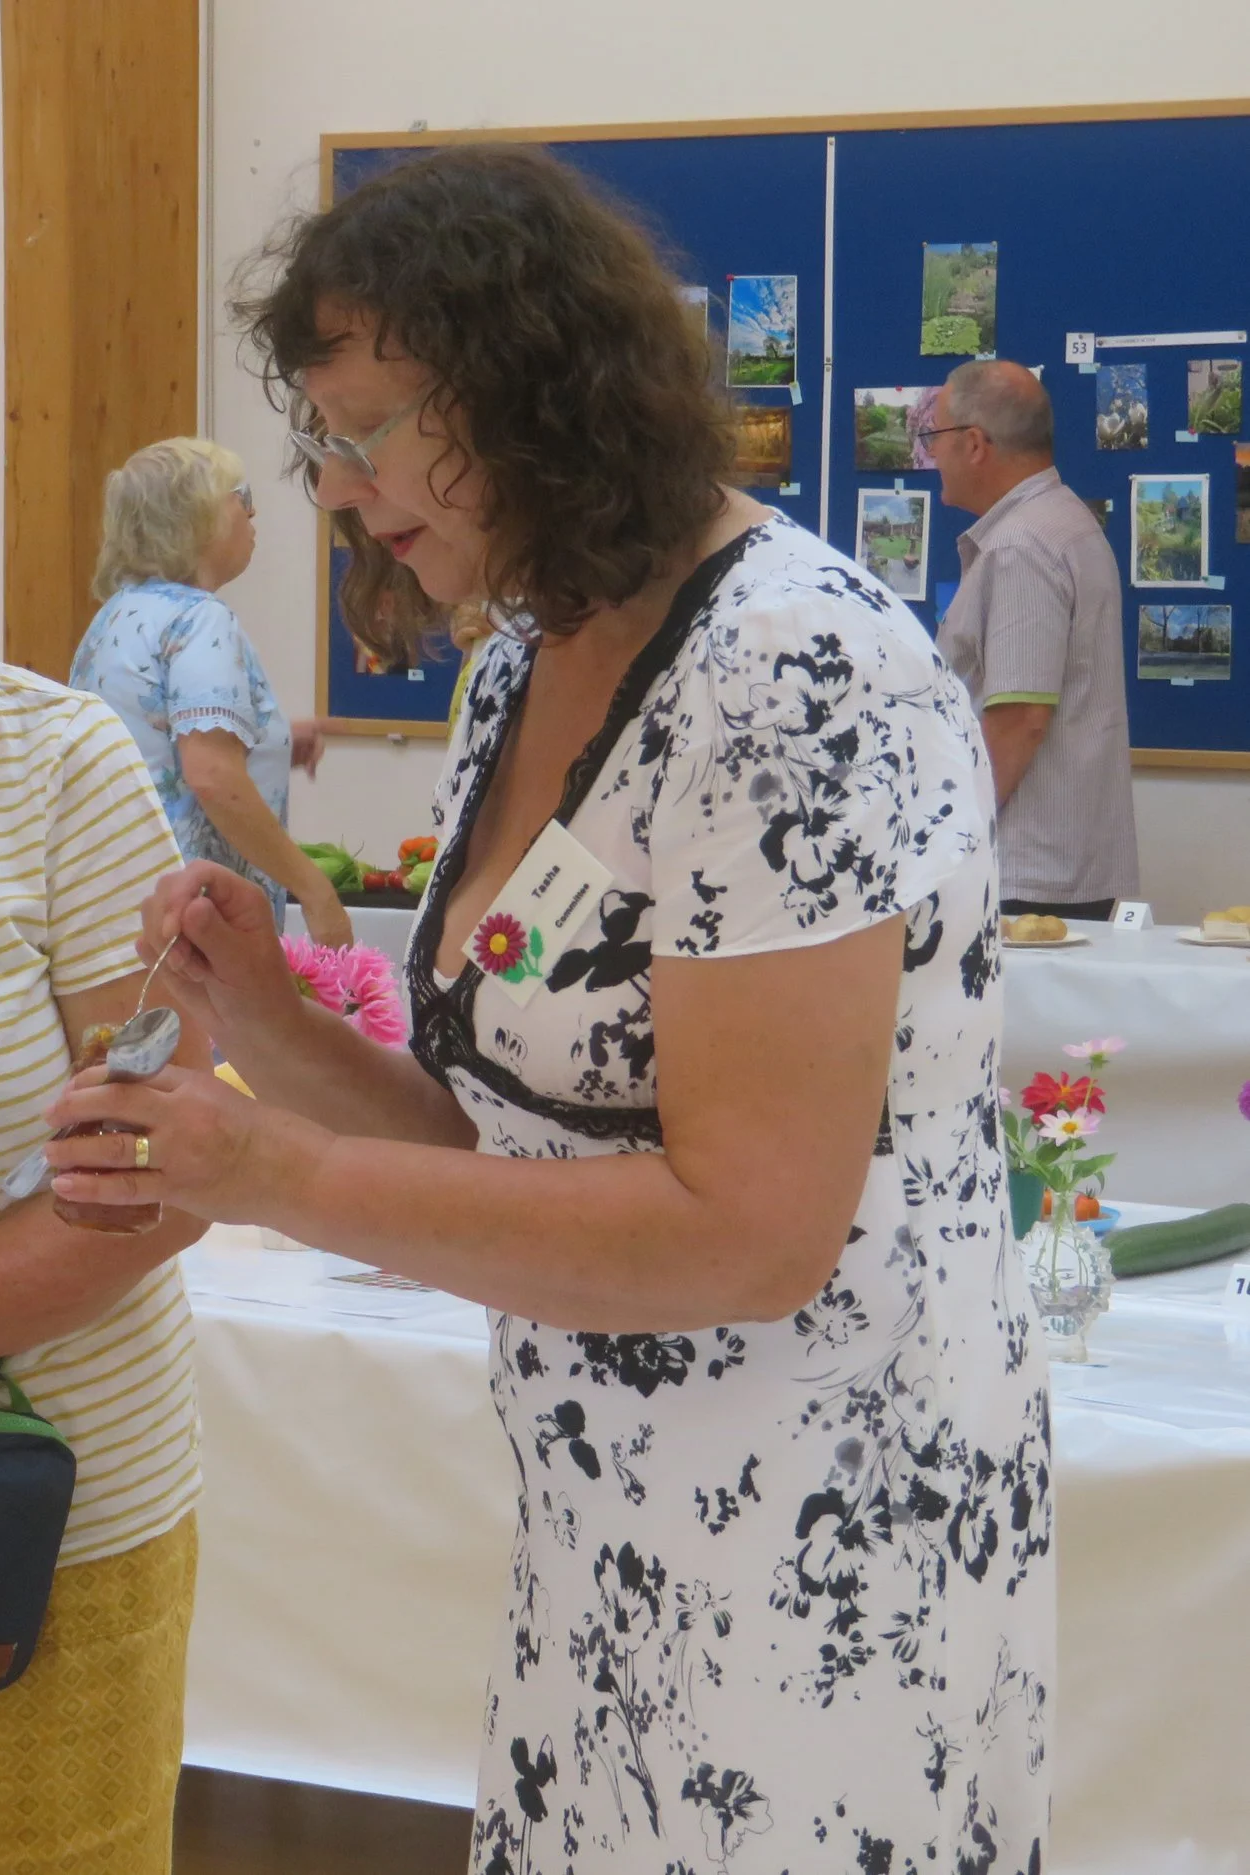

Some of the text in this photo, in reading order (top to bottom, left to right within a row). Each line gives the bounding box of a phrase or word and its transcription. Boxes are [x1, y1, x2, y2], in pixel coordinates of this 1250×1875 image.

[1072, 342, 1087, 354] 53
[531, 865, 561, 898] Tasha
[555, 883, 590, 928] Committee
[1124, 911, 1135, 922] 2
